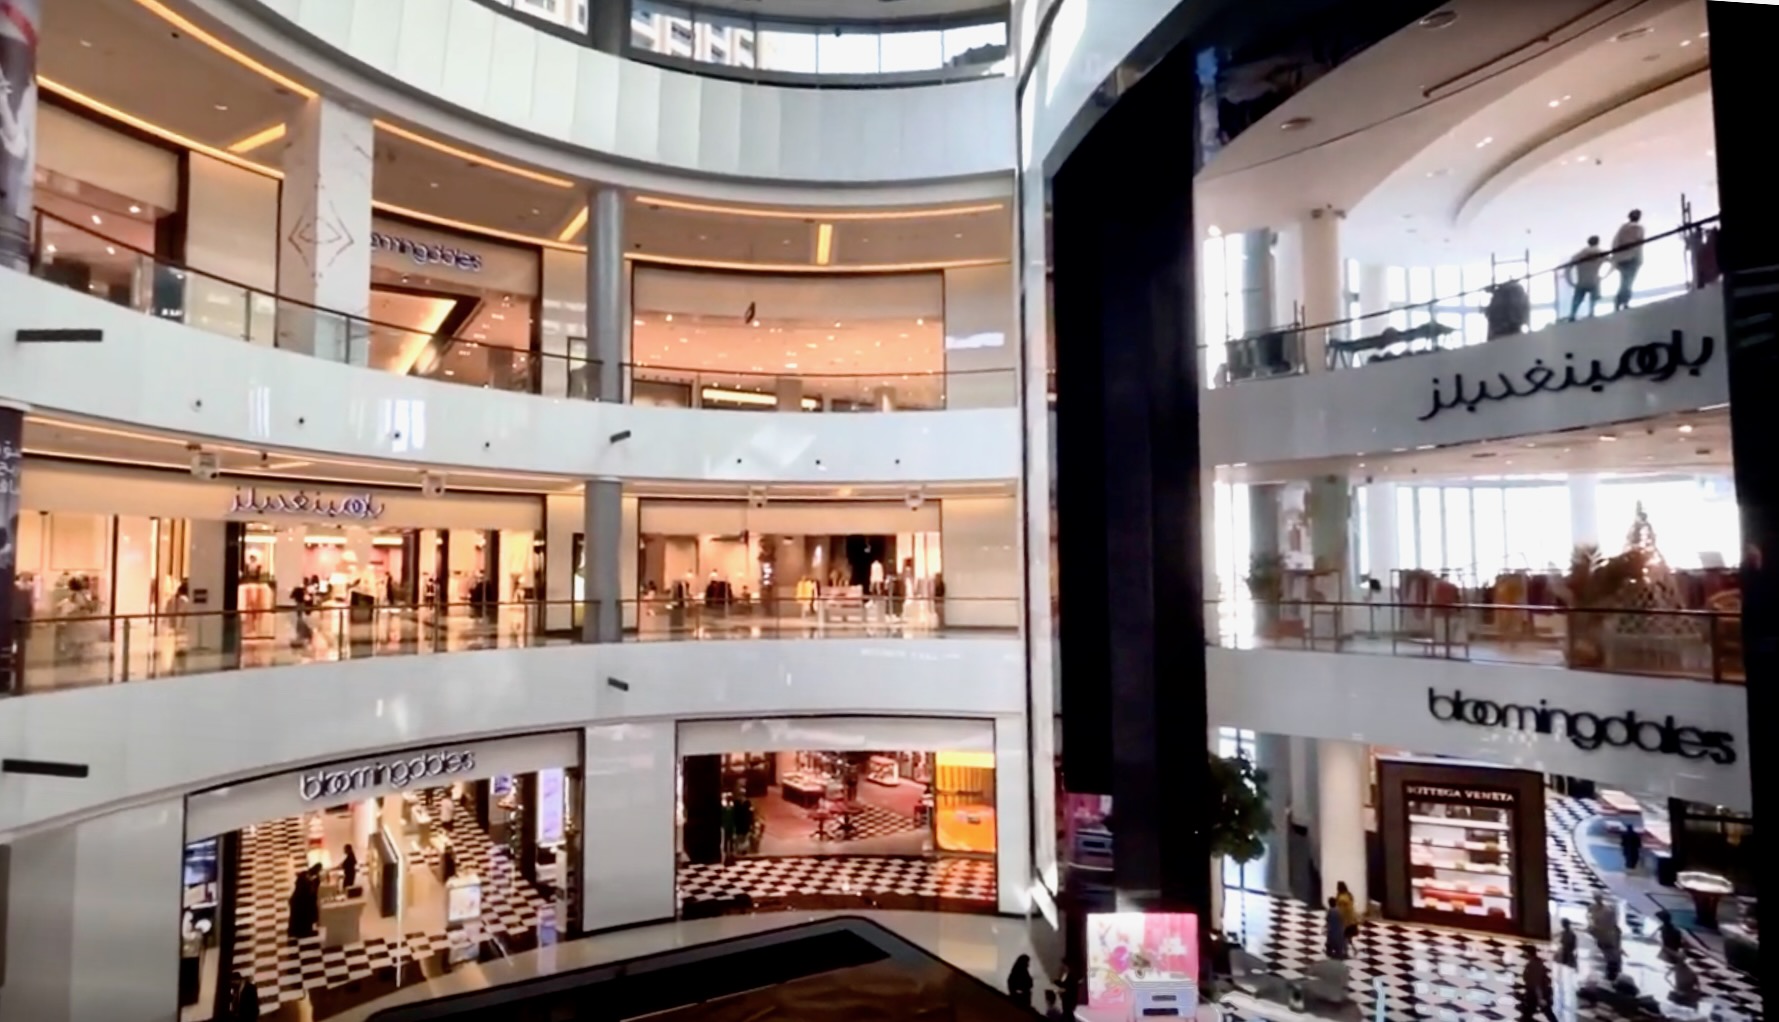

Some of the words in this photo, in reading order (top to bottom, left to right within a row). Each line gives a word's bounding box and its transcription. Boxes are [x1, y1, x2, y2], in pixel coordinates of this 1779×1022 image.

[1428, 687, 1737, 765] bloomingdales
[300, 749, 476, 801] bloomingdales
[1464, 789, 1514, 802] VENETA
